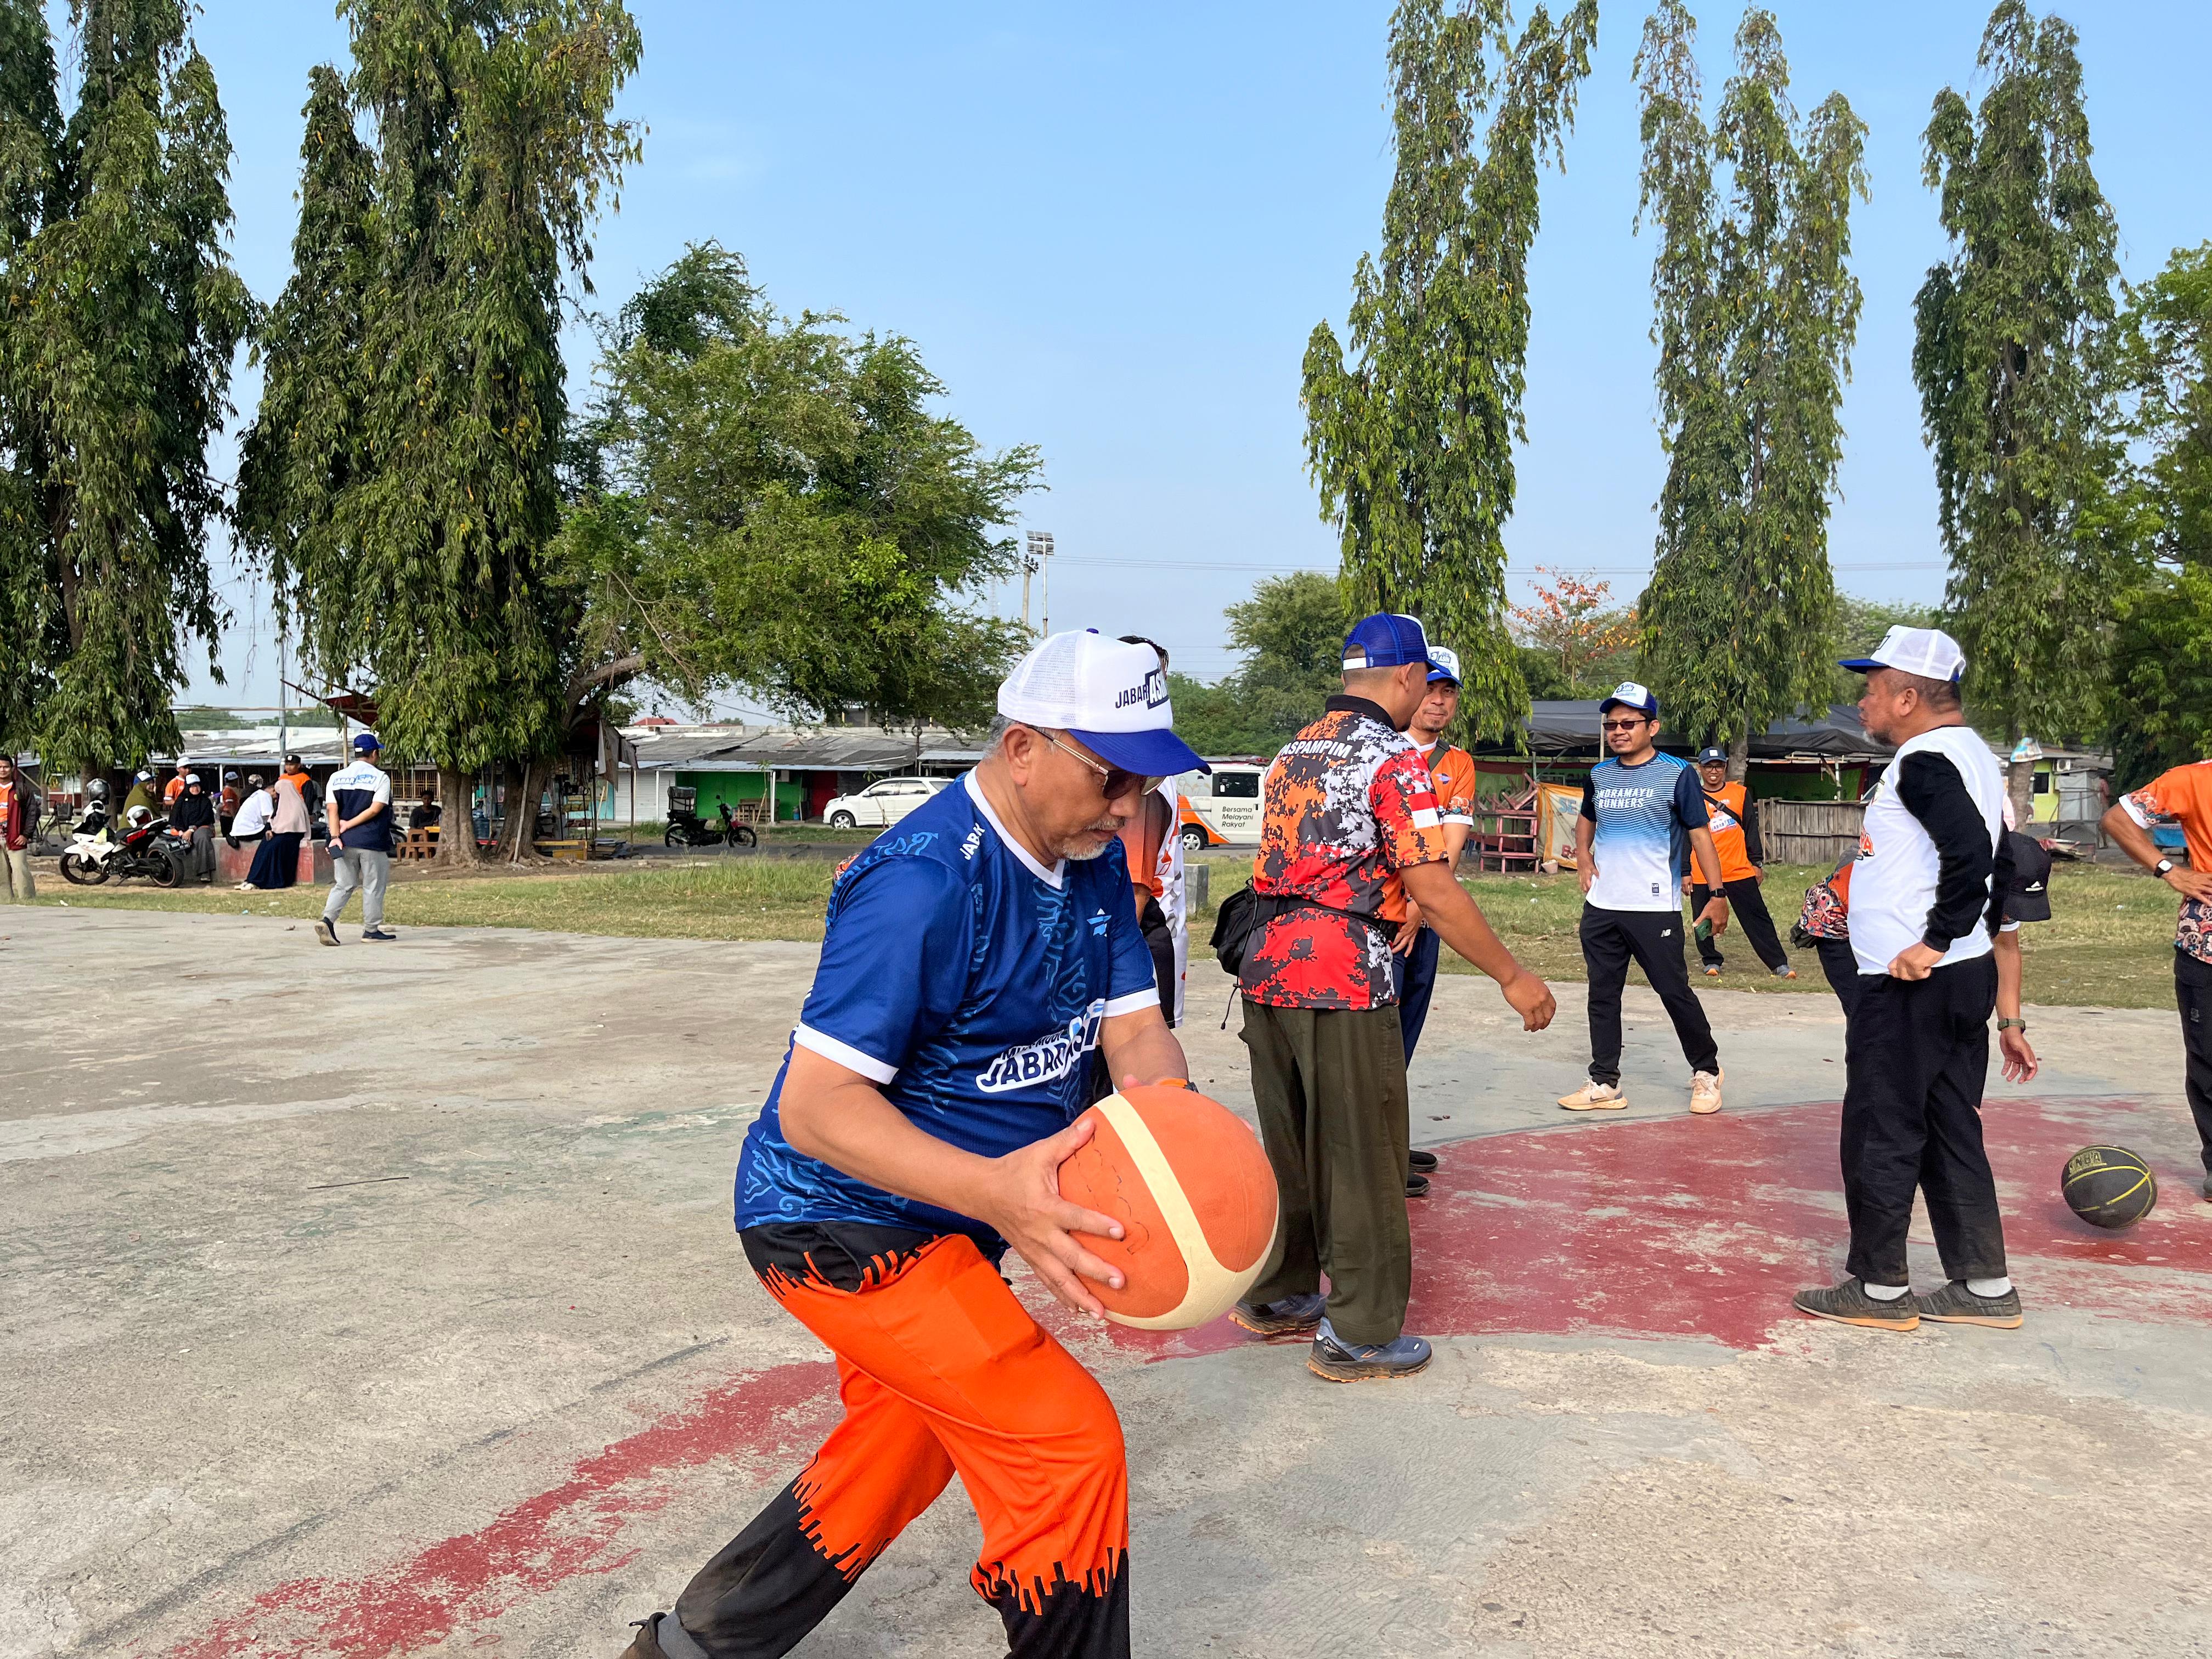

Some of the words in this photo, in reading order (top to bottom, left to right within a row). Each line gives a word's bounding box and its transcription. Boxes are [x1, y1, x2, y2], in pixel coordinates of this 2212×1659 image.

[1115, 684, 1149, 709] JABAR
[1599, 798, 1644, 809] RUNNERS
[980, 1042, 1067, 1087] JABAR
